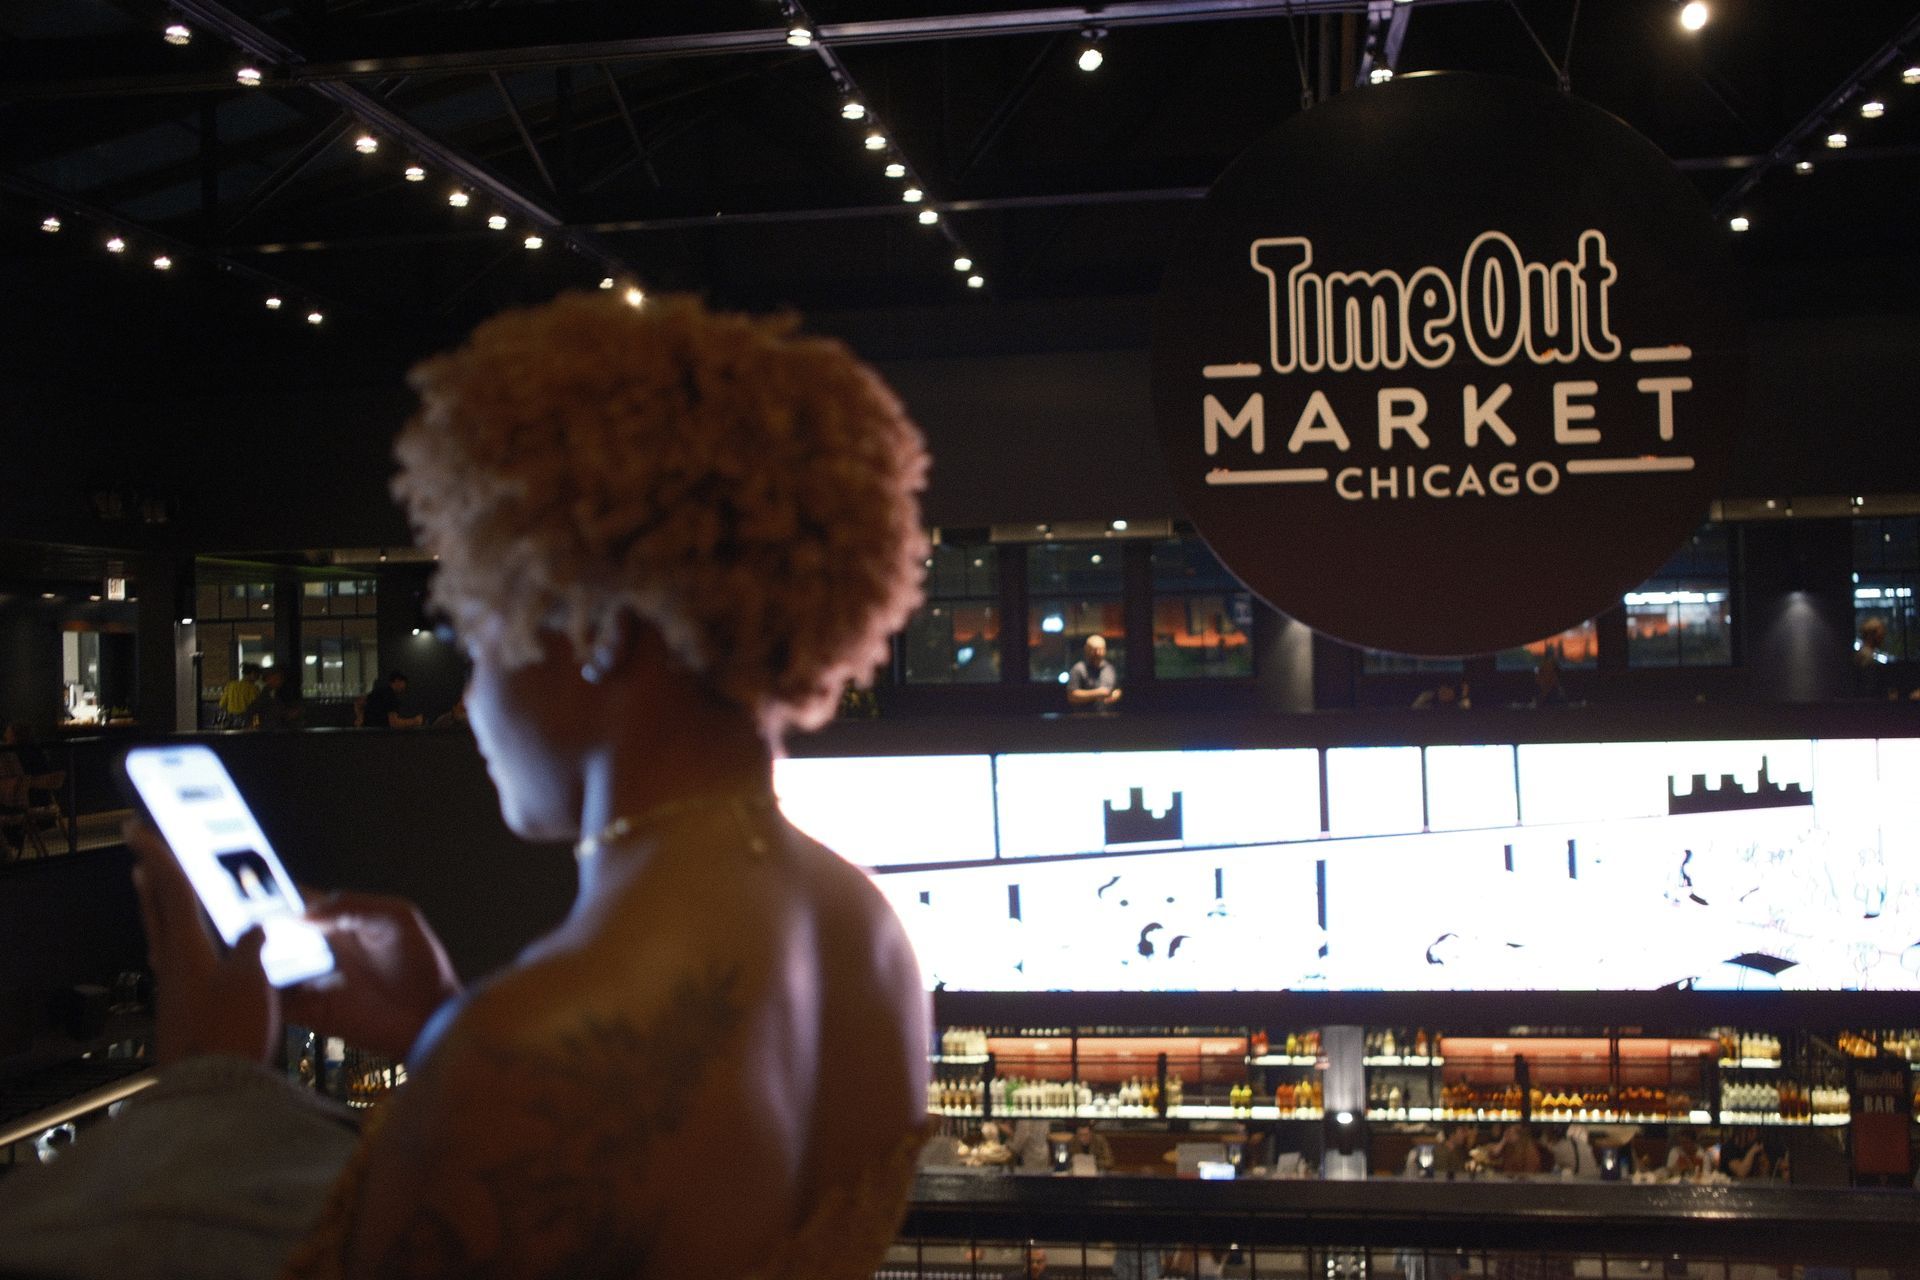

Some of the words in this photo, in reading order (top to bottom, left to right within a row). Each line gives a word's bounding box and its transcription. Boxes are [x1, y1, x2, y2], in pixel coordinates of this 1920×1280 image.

[1202, 377, 1694, 455] MARKET
[1335, 460, 1561, 501] CHICAGO
[1863, 1094, 1895, 1114] BAR
